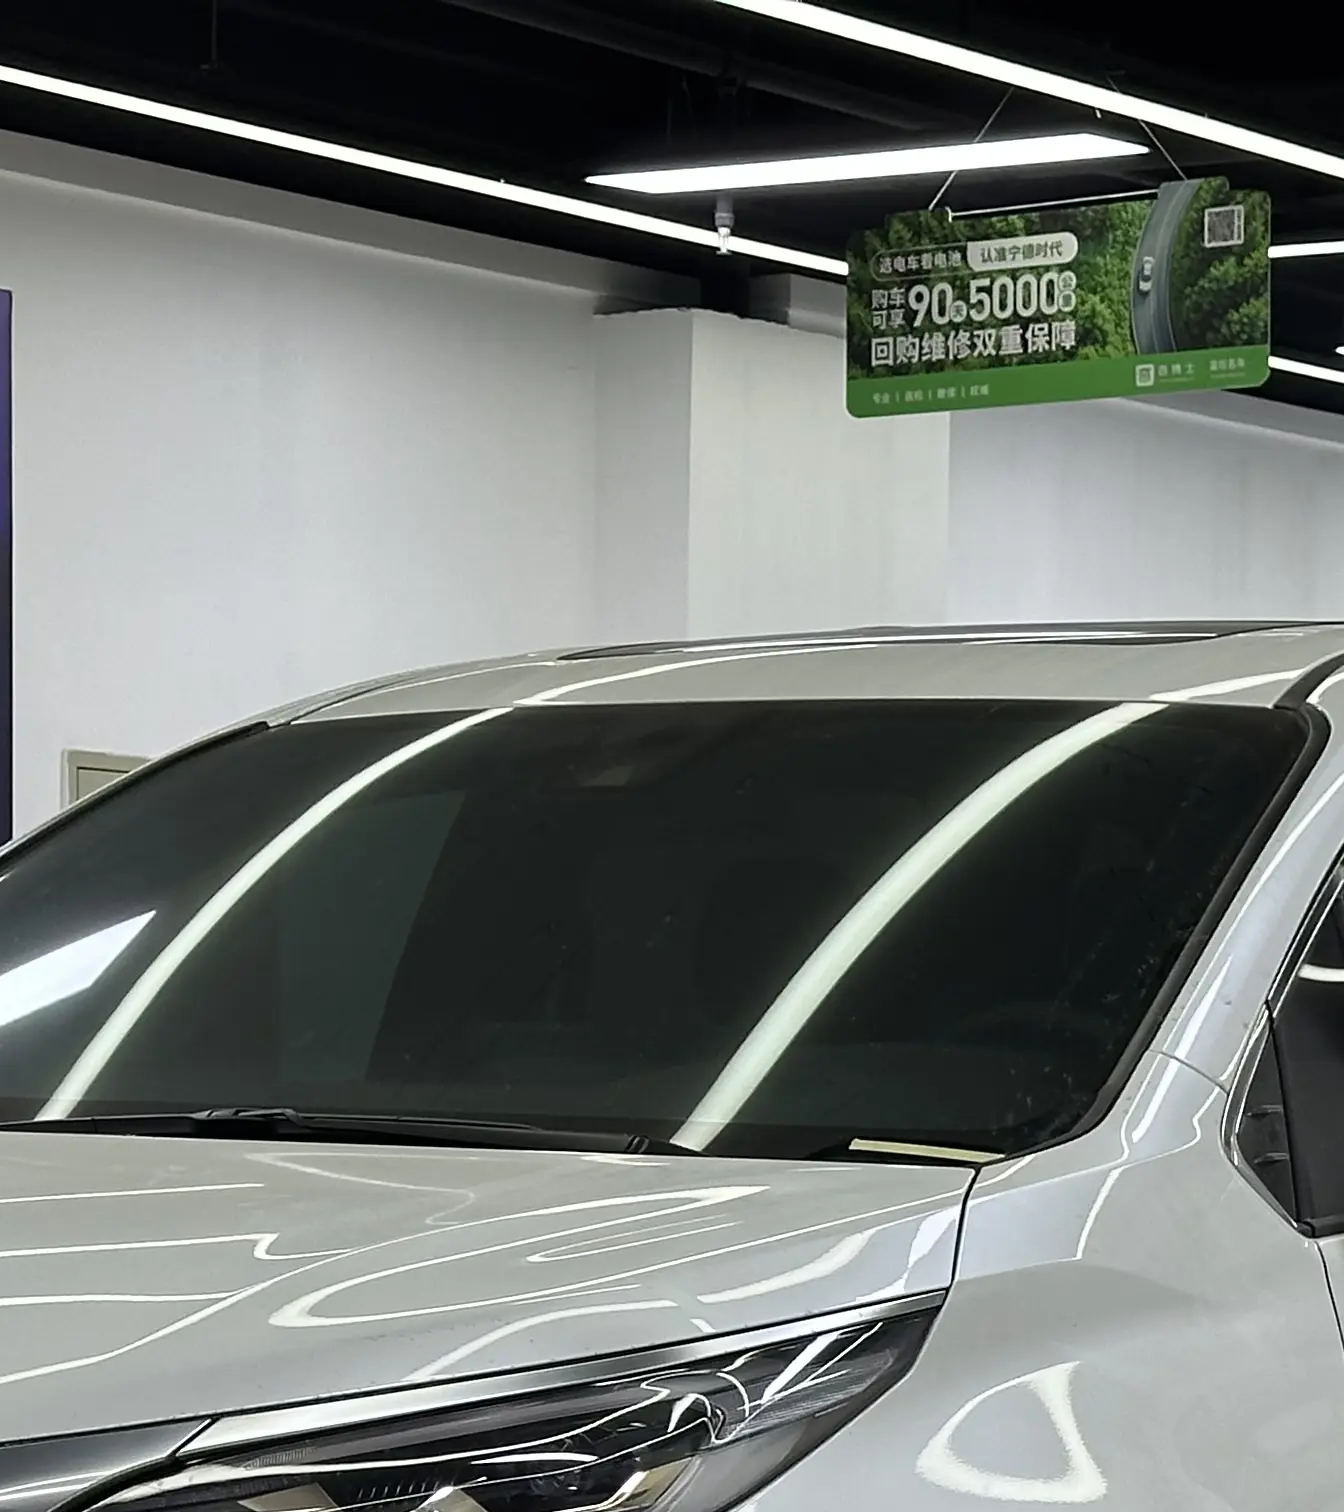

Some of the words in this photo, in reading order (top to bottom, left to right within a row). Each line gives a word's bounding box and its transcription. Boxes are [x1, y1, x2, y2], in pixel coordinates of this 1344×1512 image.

[870, 319, 1077, 367] 回购维修双重保障
